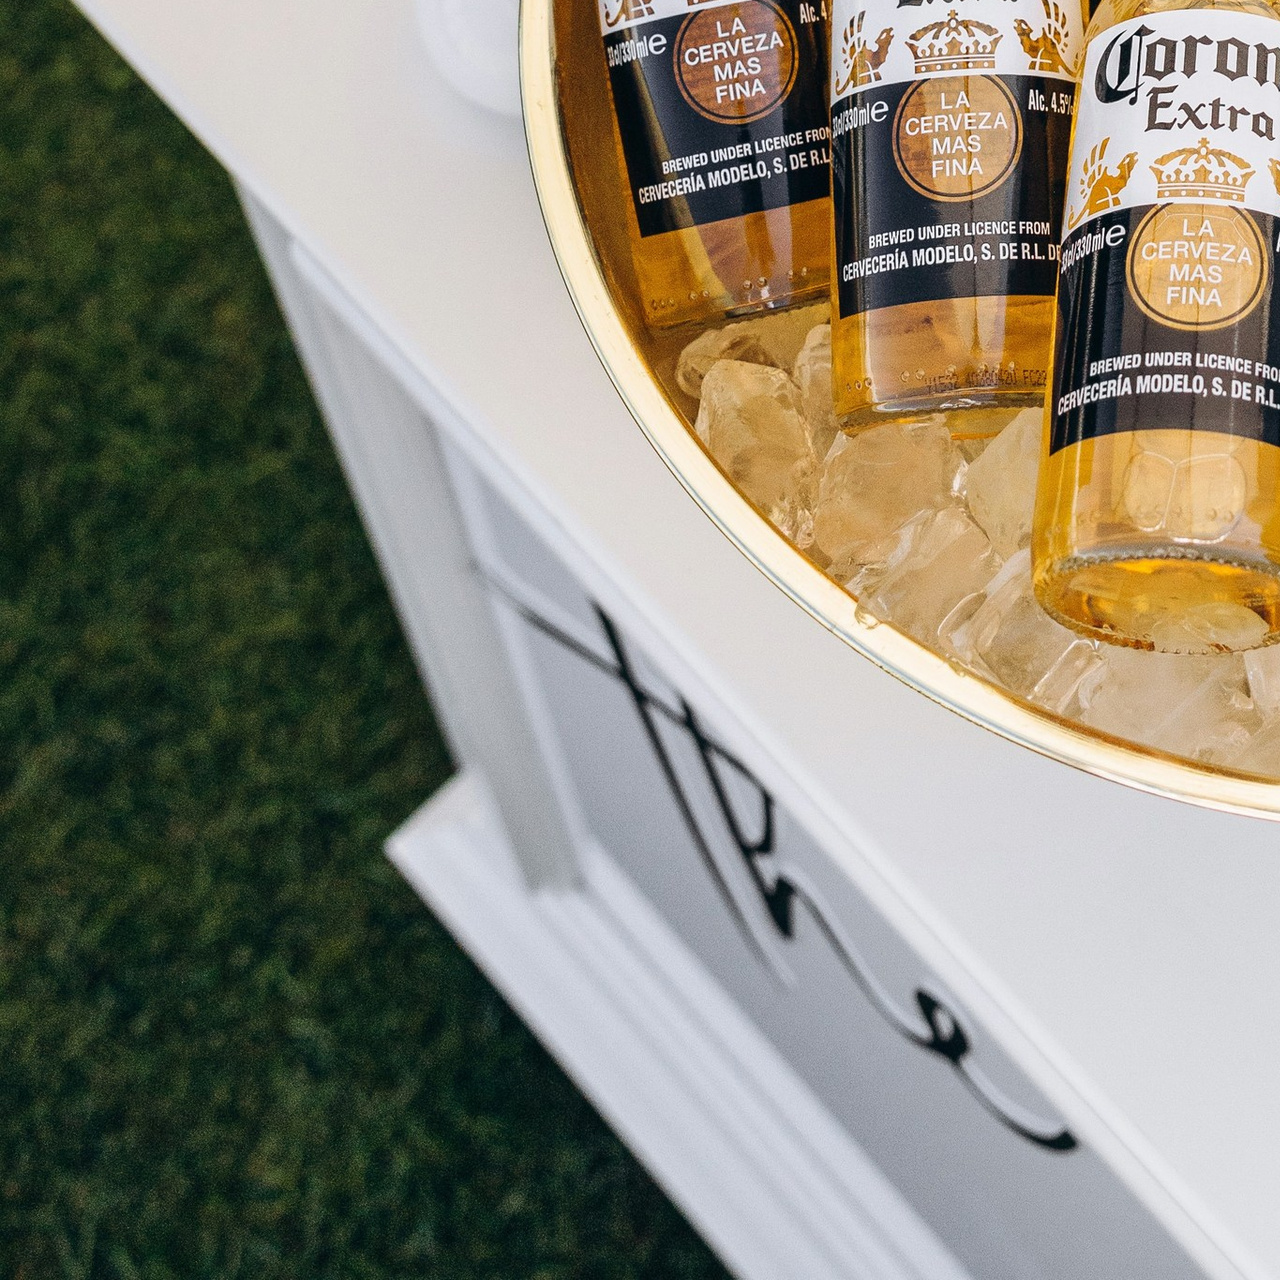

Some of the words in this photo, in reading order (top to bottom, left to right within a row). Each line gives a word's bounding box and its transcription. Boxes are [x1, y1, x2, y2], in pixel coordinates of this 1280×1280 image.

[800, 3, 819, 23] Alc.
[717, 17, 746, 38] LA
[685, 31, 784, 66] CERVEZA
[714, 57, 761, 82] MAS
[716, 79, 766, 103] FINA
[941, 91, 970, 110] LA
[1028, 89, 1048, 112] Alc.
[905, 112, 1007, 136] CERVEZA
[1145, 85, 1275, 141] Extra
[662, 154, 707, 174] BREWED
[711, 144, 752, 163] UNDER
[755, 133, 803, 154] LICENCE
[932, 135, 981, 155] MAS
[639, 173, 704, 204] CERVECERÍA
[708, 161, 771, 188] MODELO,
[774, 157, 787, 174] S.
[790, 154, 808, 170] DE
[811, 148, 831, 166] R.L
[932, 157, 983, 178] FINA
[869, 228, 914, 249] BREWED
[918, 224, 960, 241] UNDER
[964, 221, 1016, 236] LICENCE
[1019, 221, 1050, 236] FROM
[1183, 219, 1214, 237] LA
[843, 245, 908, 282] CERVECERÍA
[913, 243, 978, 267] MODELO,
[982, 243, 995, 260] S.
[1000, 243, 1018, 259] DE
[1021, 243, 1045, 260] R.L.
[1142, 241, 1253, 265] CERVEZA
[1169, 264, 1222, 284] MAS
[1167, 286, 1222, 308] FINA
[1090, 353, 1141, 377] BREWED
[1145, 352, 1191, 367] UNDER
[1195, 353, 1251, 375] LICENCE
[1058, 374, 1132, 416] CERVECERÍA
[1136, 374, 1208, 398] MODELO,
[1211, 378, 1227, 397] S.
[1231, 380, 1251, 401] DE
[1255, 385, 1280, 410] R.L.
